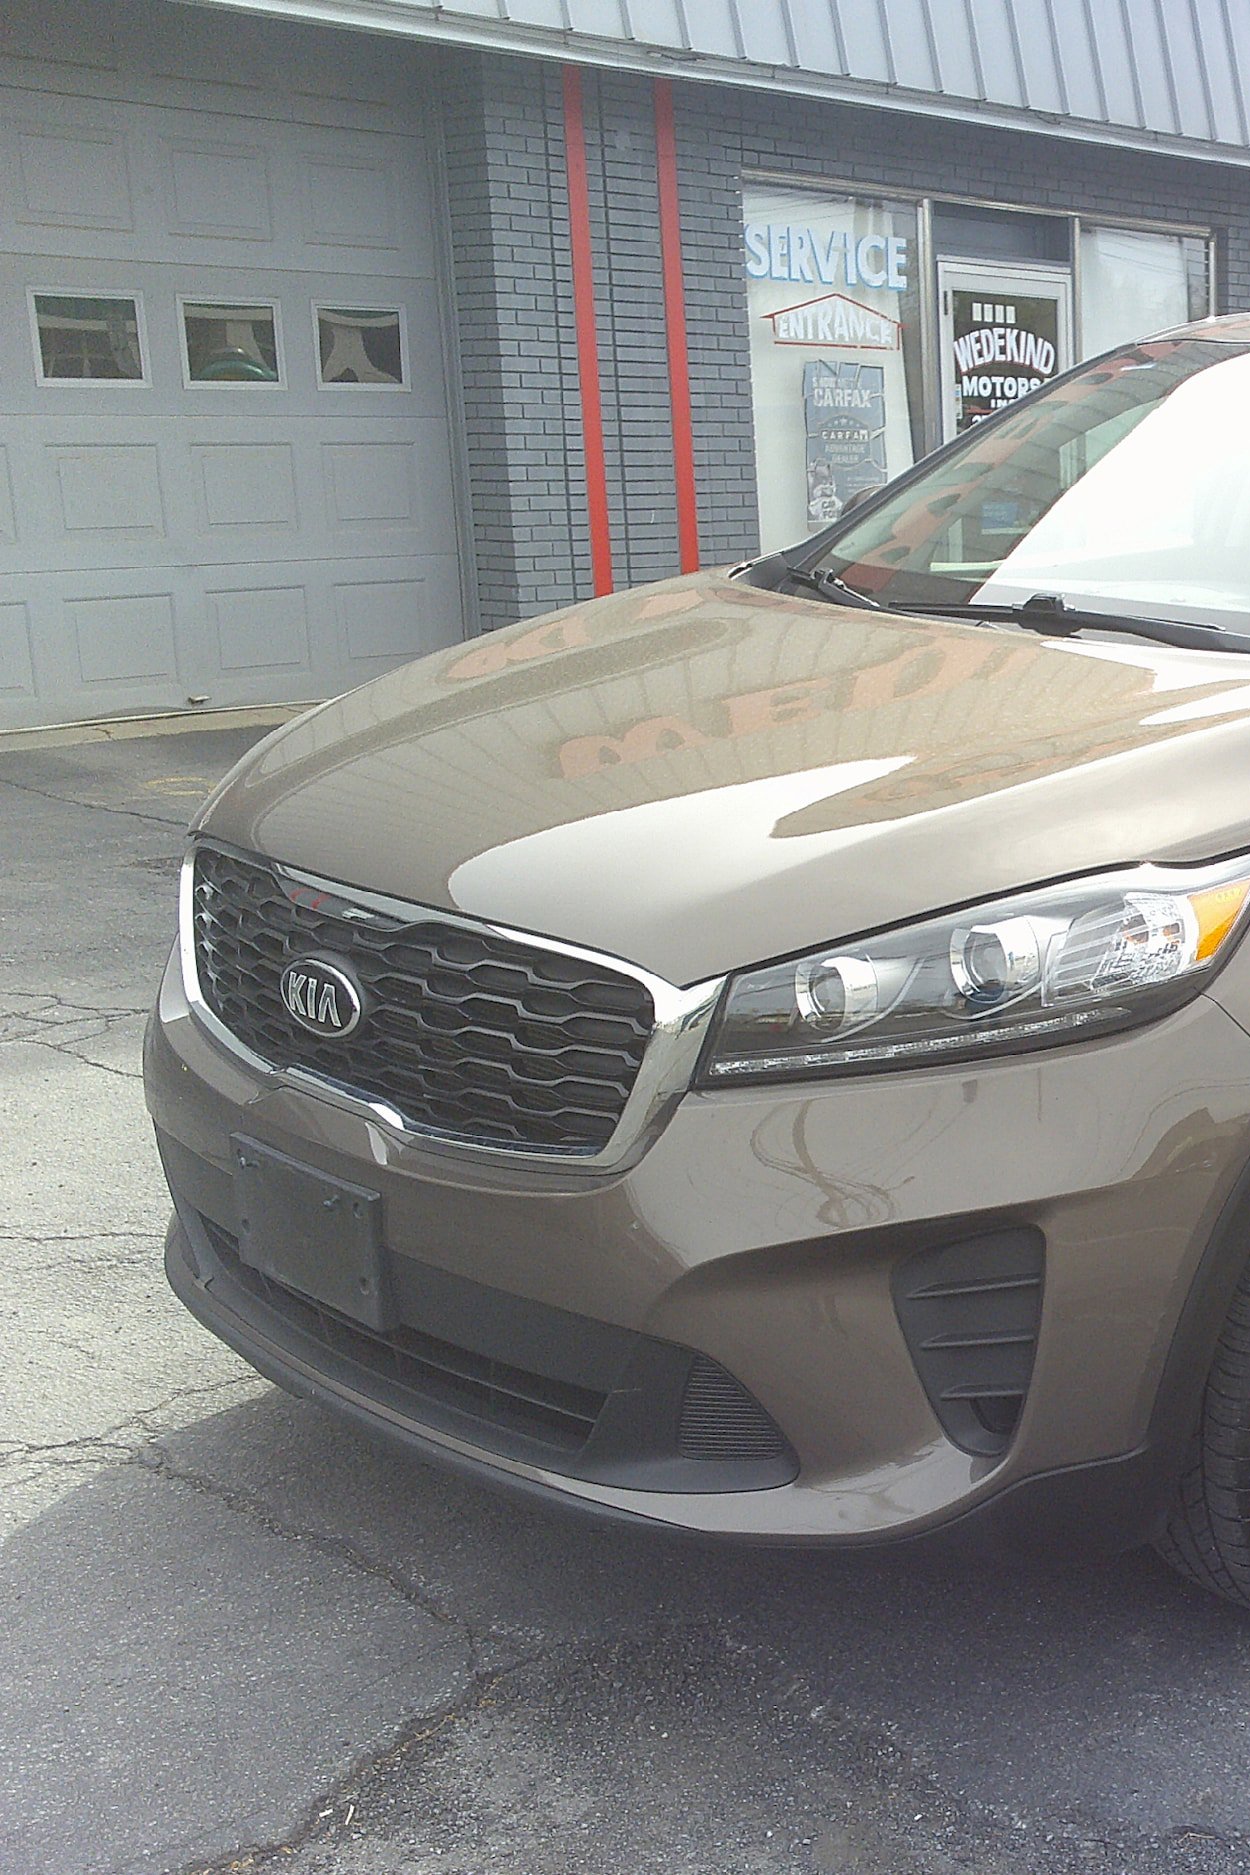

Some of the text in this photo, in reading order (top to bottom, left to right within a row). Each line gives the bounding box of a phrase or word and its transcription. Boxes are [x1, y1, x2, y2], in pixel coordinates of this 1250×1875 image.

[744, 223, 907, 291] SERVICE
[778, 301, 892, 343] ENTRANCE
[953, 327, 1055, 375] WEDEKIND
[813, 388, 872, 408] CARFAX
[288, 971, 342, 1028] KIA
